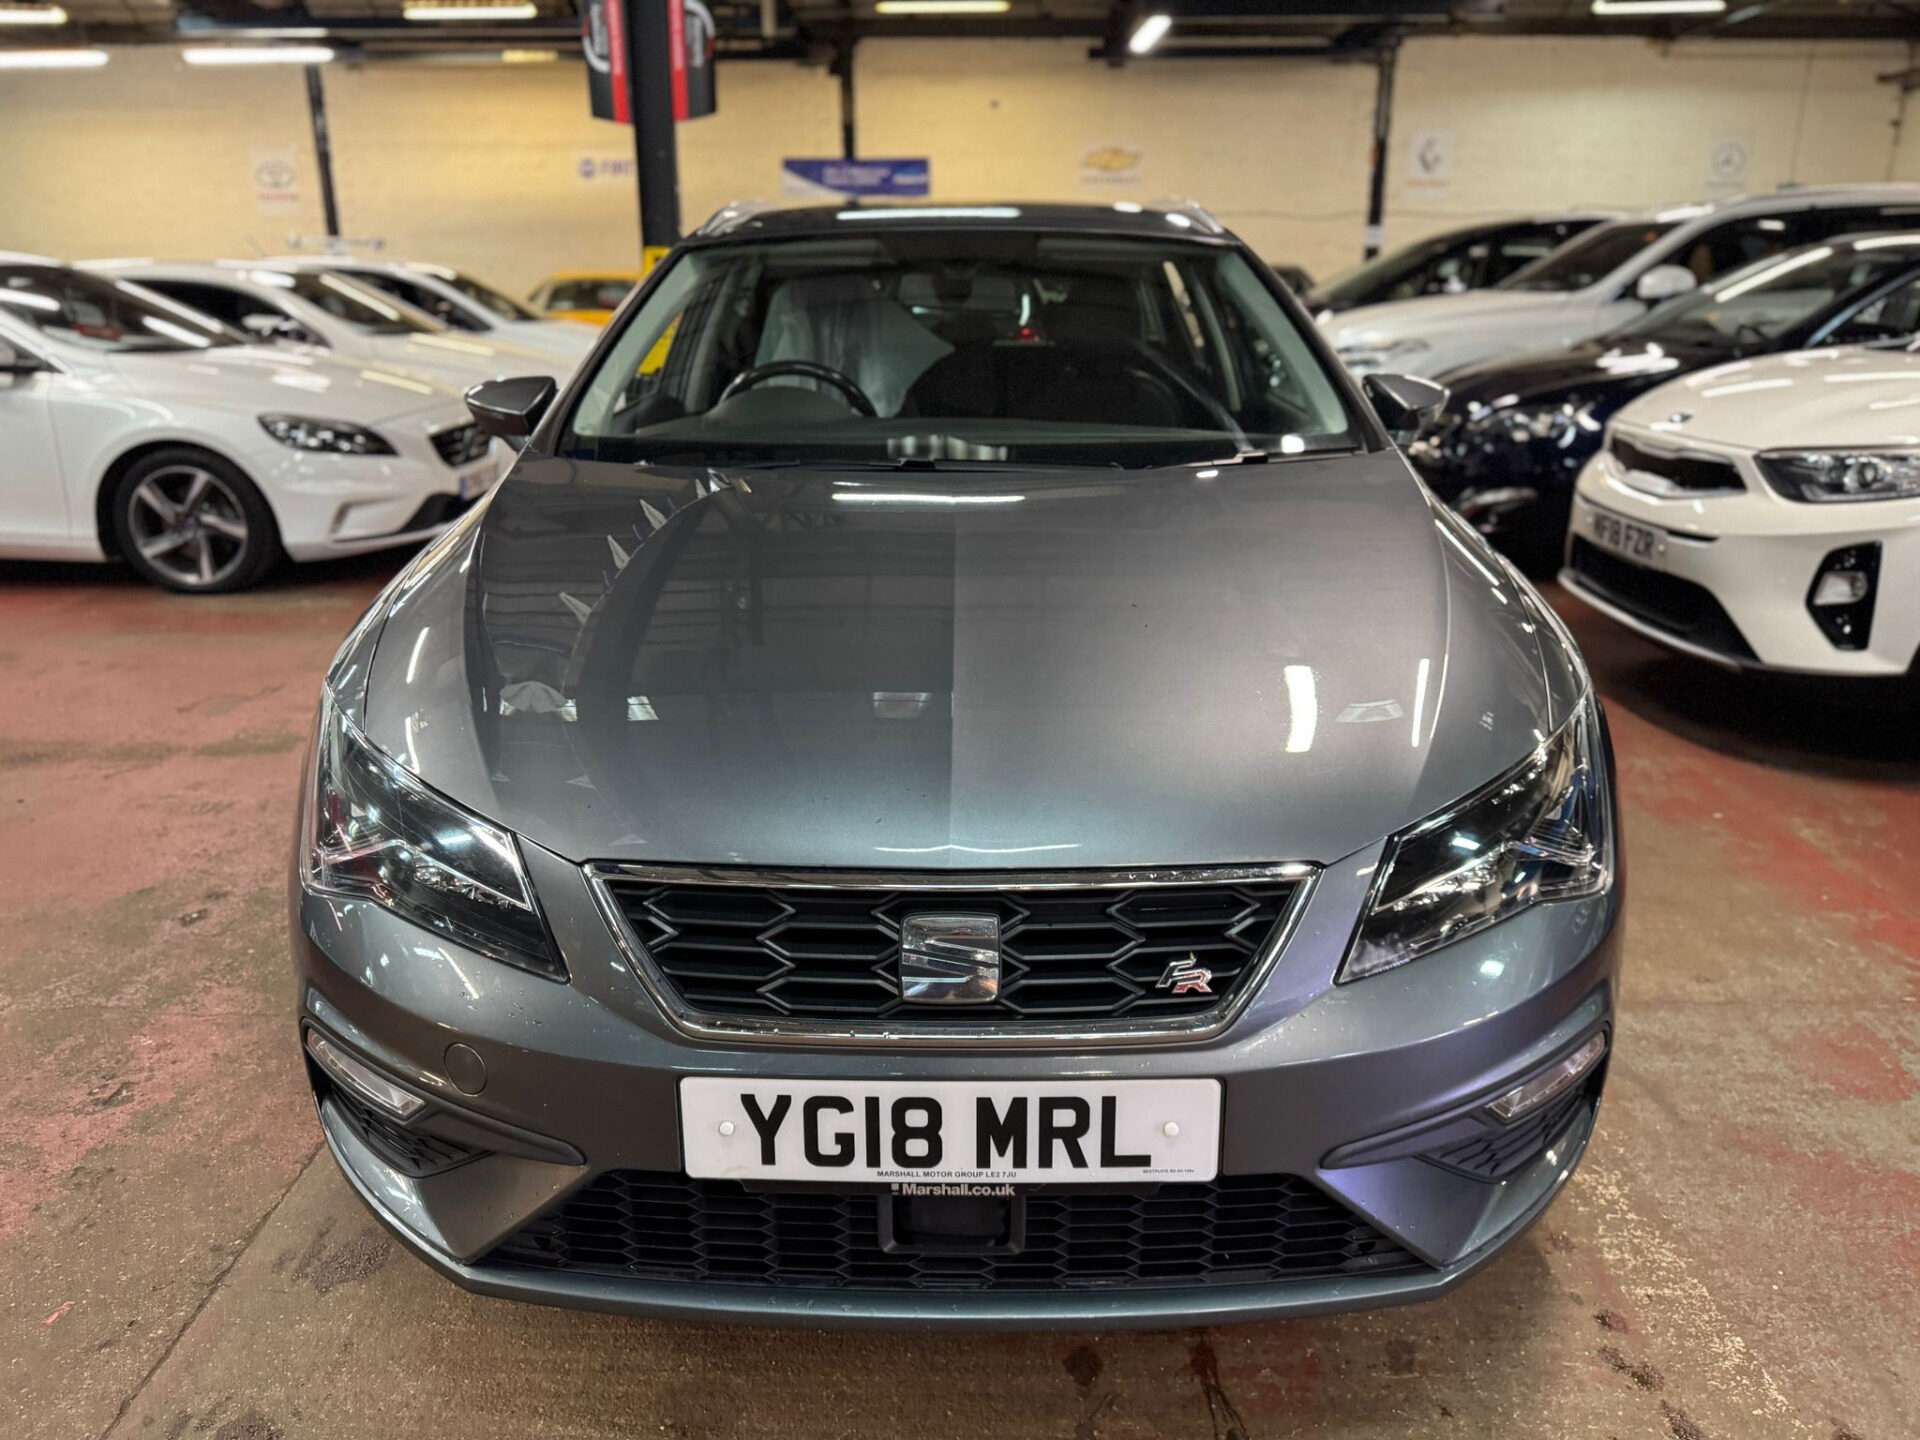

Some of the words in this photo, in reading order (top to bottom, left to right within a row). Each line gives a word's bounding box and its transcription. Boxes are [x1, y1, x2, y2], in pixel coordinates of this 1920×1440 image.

[740, 1093, 943, 1168] YG18
[976, 1095, 1151, 1169] MRL
[877, 1170, 920, 1178] MARSHALL
[923, 1170, 953, 1178] MOTOR
[955, 1170, 984, 1178] GROUP
[902, 1183, 1016, 1196] Marshall.co.uk
